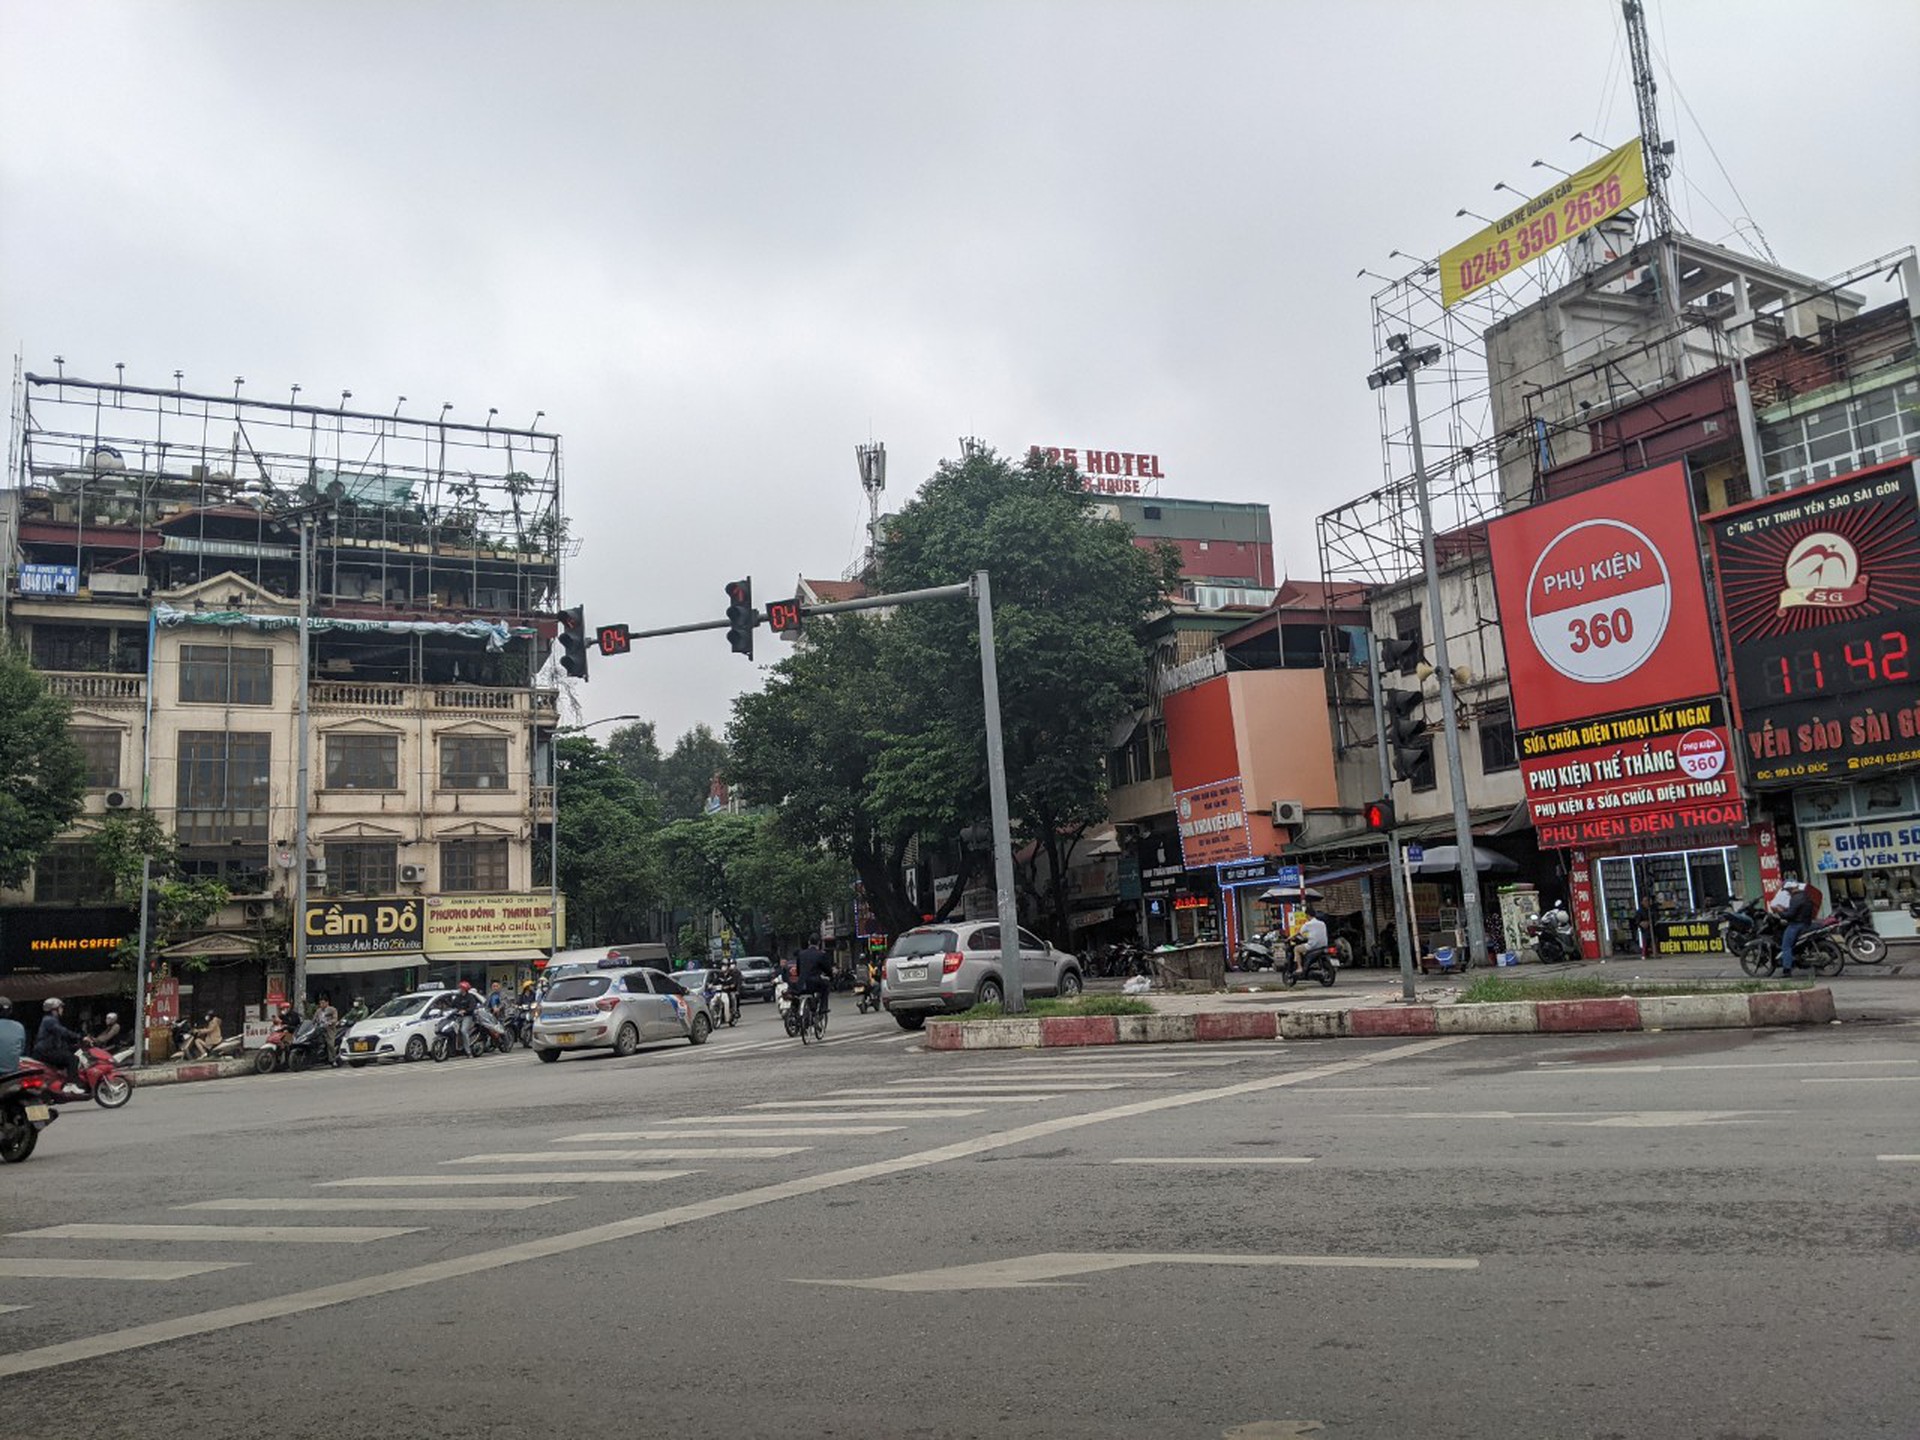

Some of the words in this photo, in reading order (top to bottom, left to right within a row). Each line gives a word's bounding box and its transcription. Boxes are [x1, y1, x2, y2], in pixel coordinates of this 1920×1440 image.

[1459, 238, 1511, 292] 0243
[1516, 211, 1558, 261] 350
[1563, 173, 1622, 235] 2636
[1086, 450, 1165, 478] HOTEL
[1757, 516, 1770, 529] TY
[1773, 508, 1801, 524] TNHH
[1803, 500, 1826, 515] YẾN
[1829, 494, 1850, 509] SÀO
[1853, 488, 1873, 503] SÀI
[1876, 480, 1900, 497] GÒN
[1543, 566, 1585, 595] PHỤ
[1591, 551, 1642, 581] KIỆN
[770, 605, 798, 629] 04
[1568, 607, 1633, 654] 360
[602, 629, 626, 652] 04
[1581, 722, 1610, 746] ĐIỆN
[1611, 715, 1650, 739] THOẠI
[1651, 707, 1674, 733] LẤY
[1675, 704, 1711, 728] NGAY
[1748, 718, 1792, 760] YẾN
[1798, 715, 1843, 753] SÀO
[1850, 707, 1891, 745] SÀI
[1529, 768, 1557, 793] PHỤ
[1558, 760, 1593, 789] KIỆN
[1594, 749, 1622, 781] THẾ
[1623, 742, 1676, 777] THẮNG
[1686, 755, 1718, 772] 360
[1534, 802, 1556, 818] PHỤ
[1557, 796, 1584, 816] KIỆN
[1586, 797, 1595, 811] &
[1597, 789, 1621, 809] SỬA
[1656, 783, 1687, 803] ĐIỆN
[1687, 779, 1727, 798] THOẠI
[1542, 824, 1578, 845] PHỤ
[1583, 818, 1626, 843] KIỆN
[1629, 811, 1675, 838] ĐIỆN
[1679, 804, 1744, 826] THOẠI
[306, 903, 368, 936] Cầm
[375, 900, 418, 935] Đồ
[31, 936, 77, 951] KHÁNH
